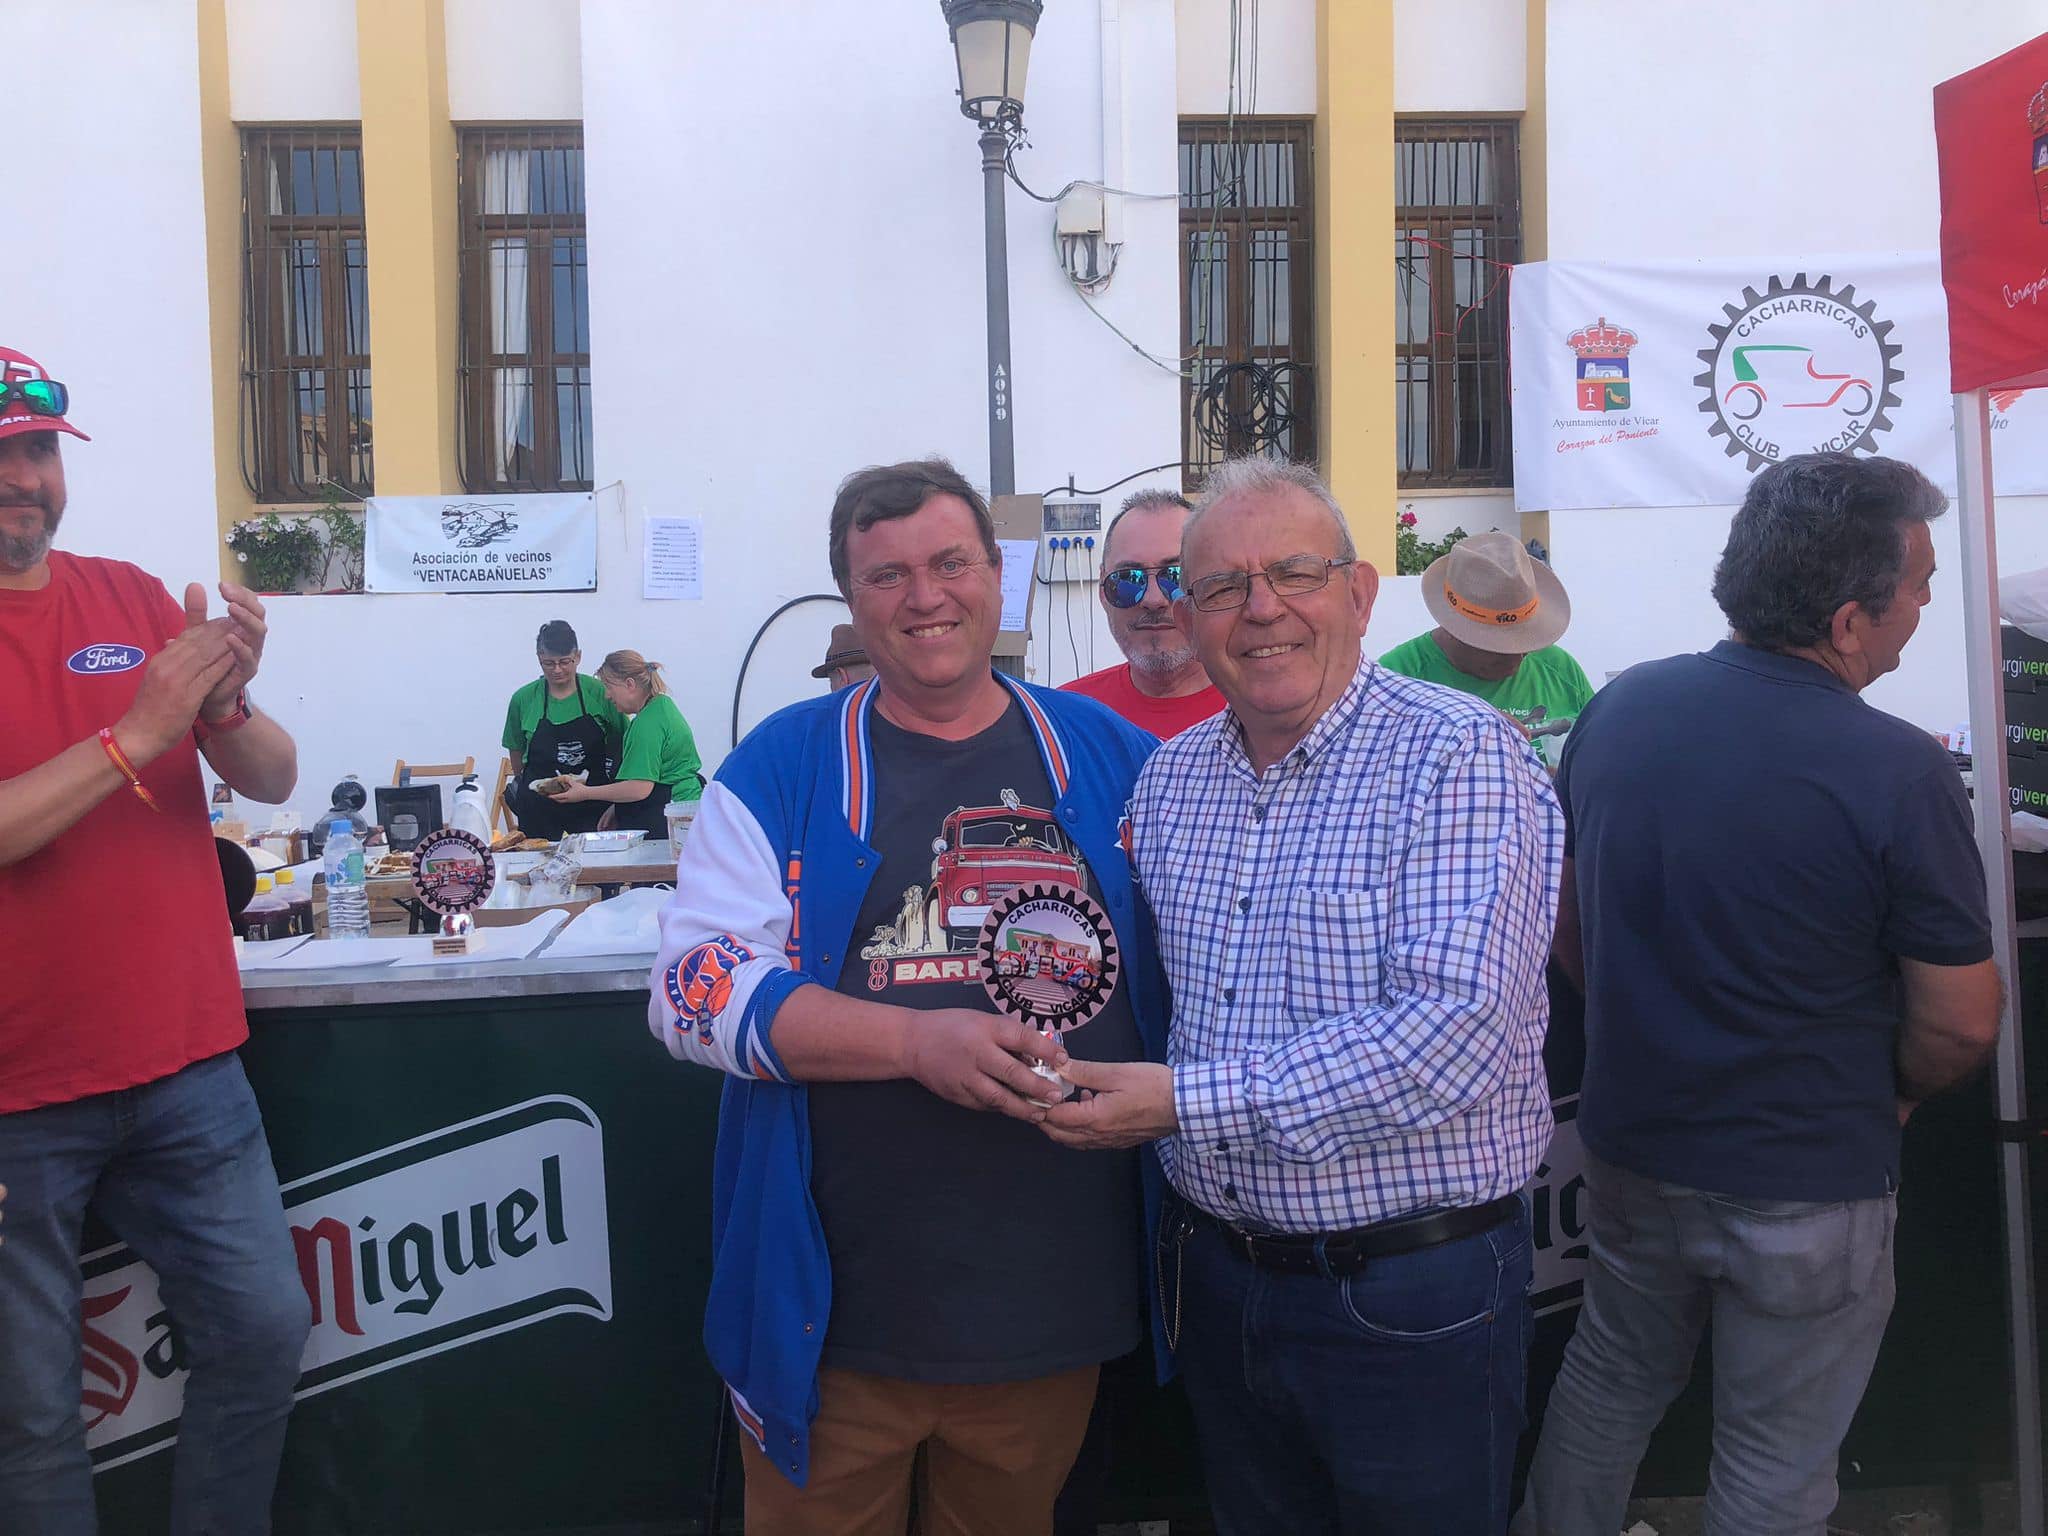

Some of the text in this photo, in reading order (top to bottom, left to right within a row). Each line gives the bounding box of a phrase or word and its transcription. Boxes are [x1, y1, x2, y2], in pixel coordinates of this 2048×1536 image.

[2003, 268, 2048, 308] Corazó
[1737, 299, 1868, 339] CACHARRICAS
[1552, 416, 1617, 429] Ayuntamiento
[1619, 416, 1631, 426] de
[1599, 433, 1613, 443] del
[1616, 426, 1659, 442] Poniente
[1736, 420, 1866, 458] CLUB VICAR
[412, 550, 552, 565] Asociación de vecinos
[86, 648, 131, 669] Ford
[1008, 901, 1096, 939] CACHARRICAS
[1002, 978, 1090, 1014] CLUB VICAR
[290, 1155, 568, 1336] Miguel
